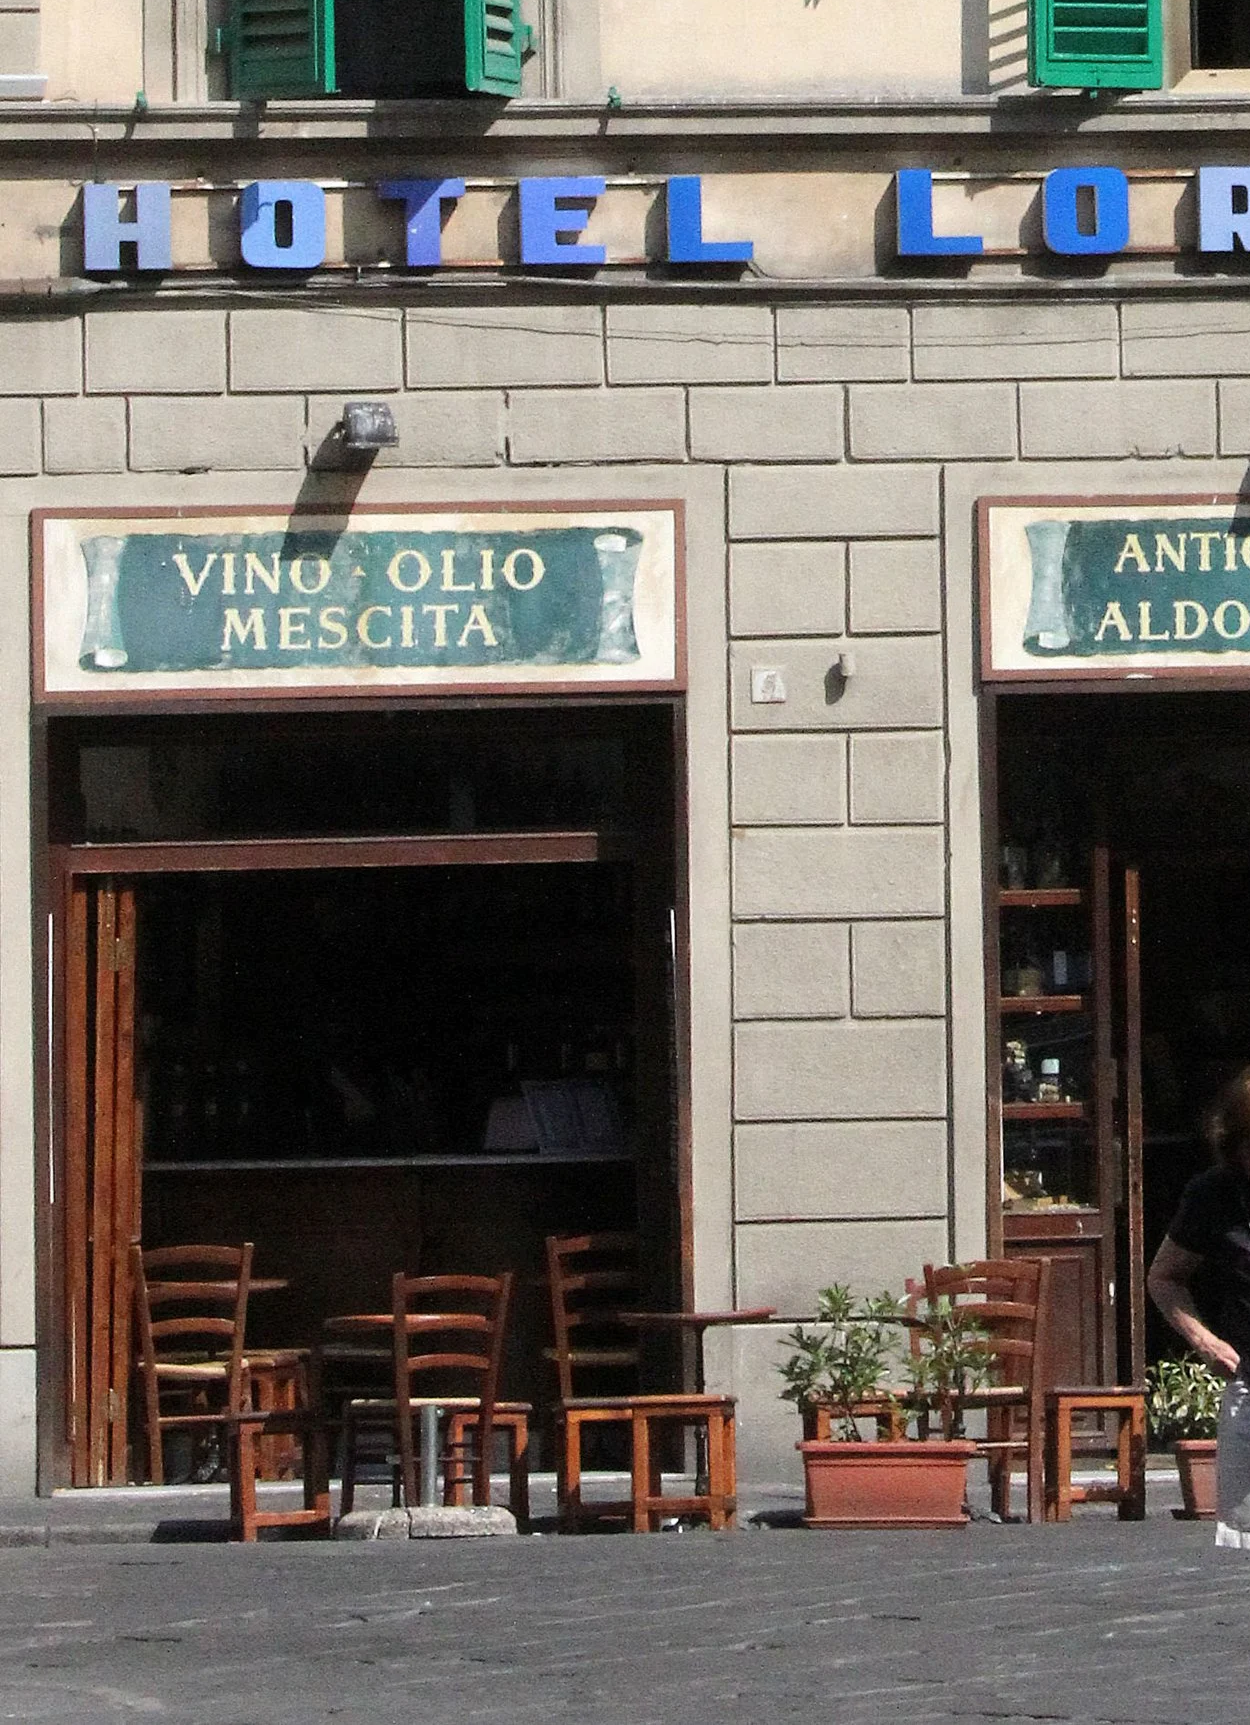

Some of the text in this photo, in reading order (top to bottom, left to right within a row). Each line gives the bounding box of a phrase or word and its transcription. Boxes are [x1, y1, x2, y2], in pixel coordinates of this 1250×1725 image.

[83, 176, 754, 272] HOTEL
[172, 548, 547, 596] VINO OLIO
[220, 602, 500, 652] MESCITA
